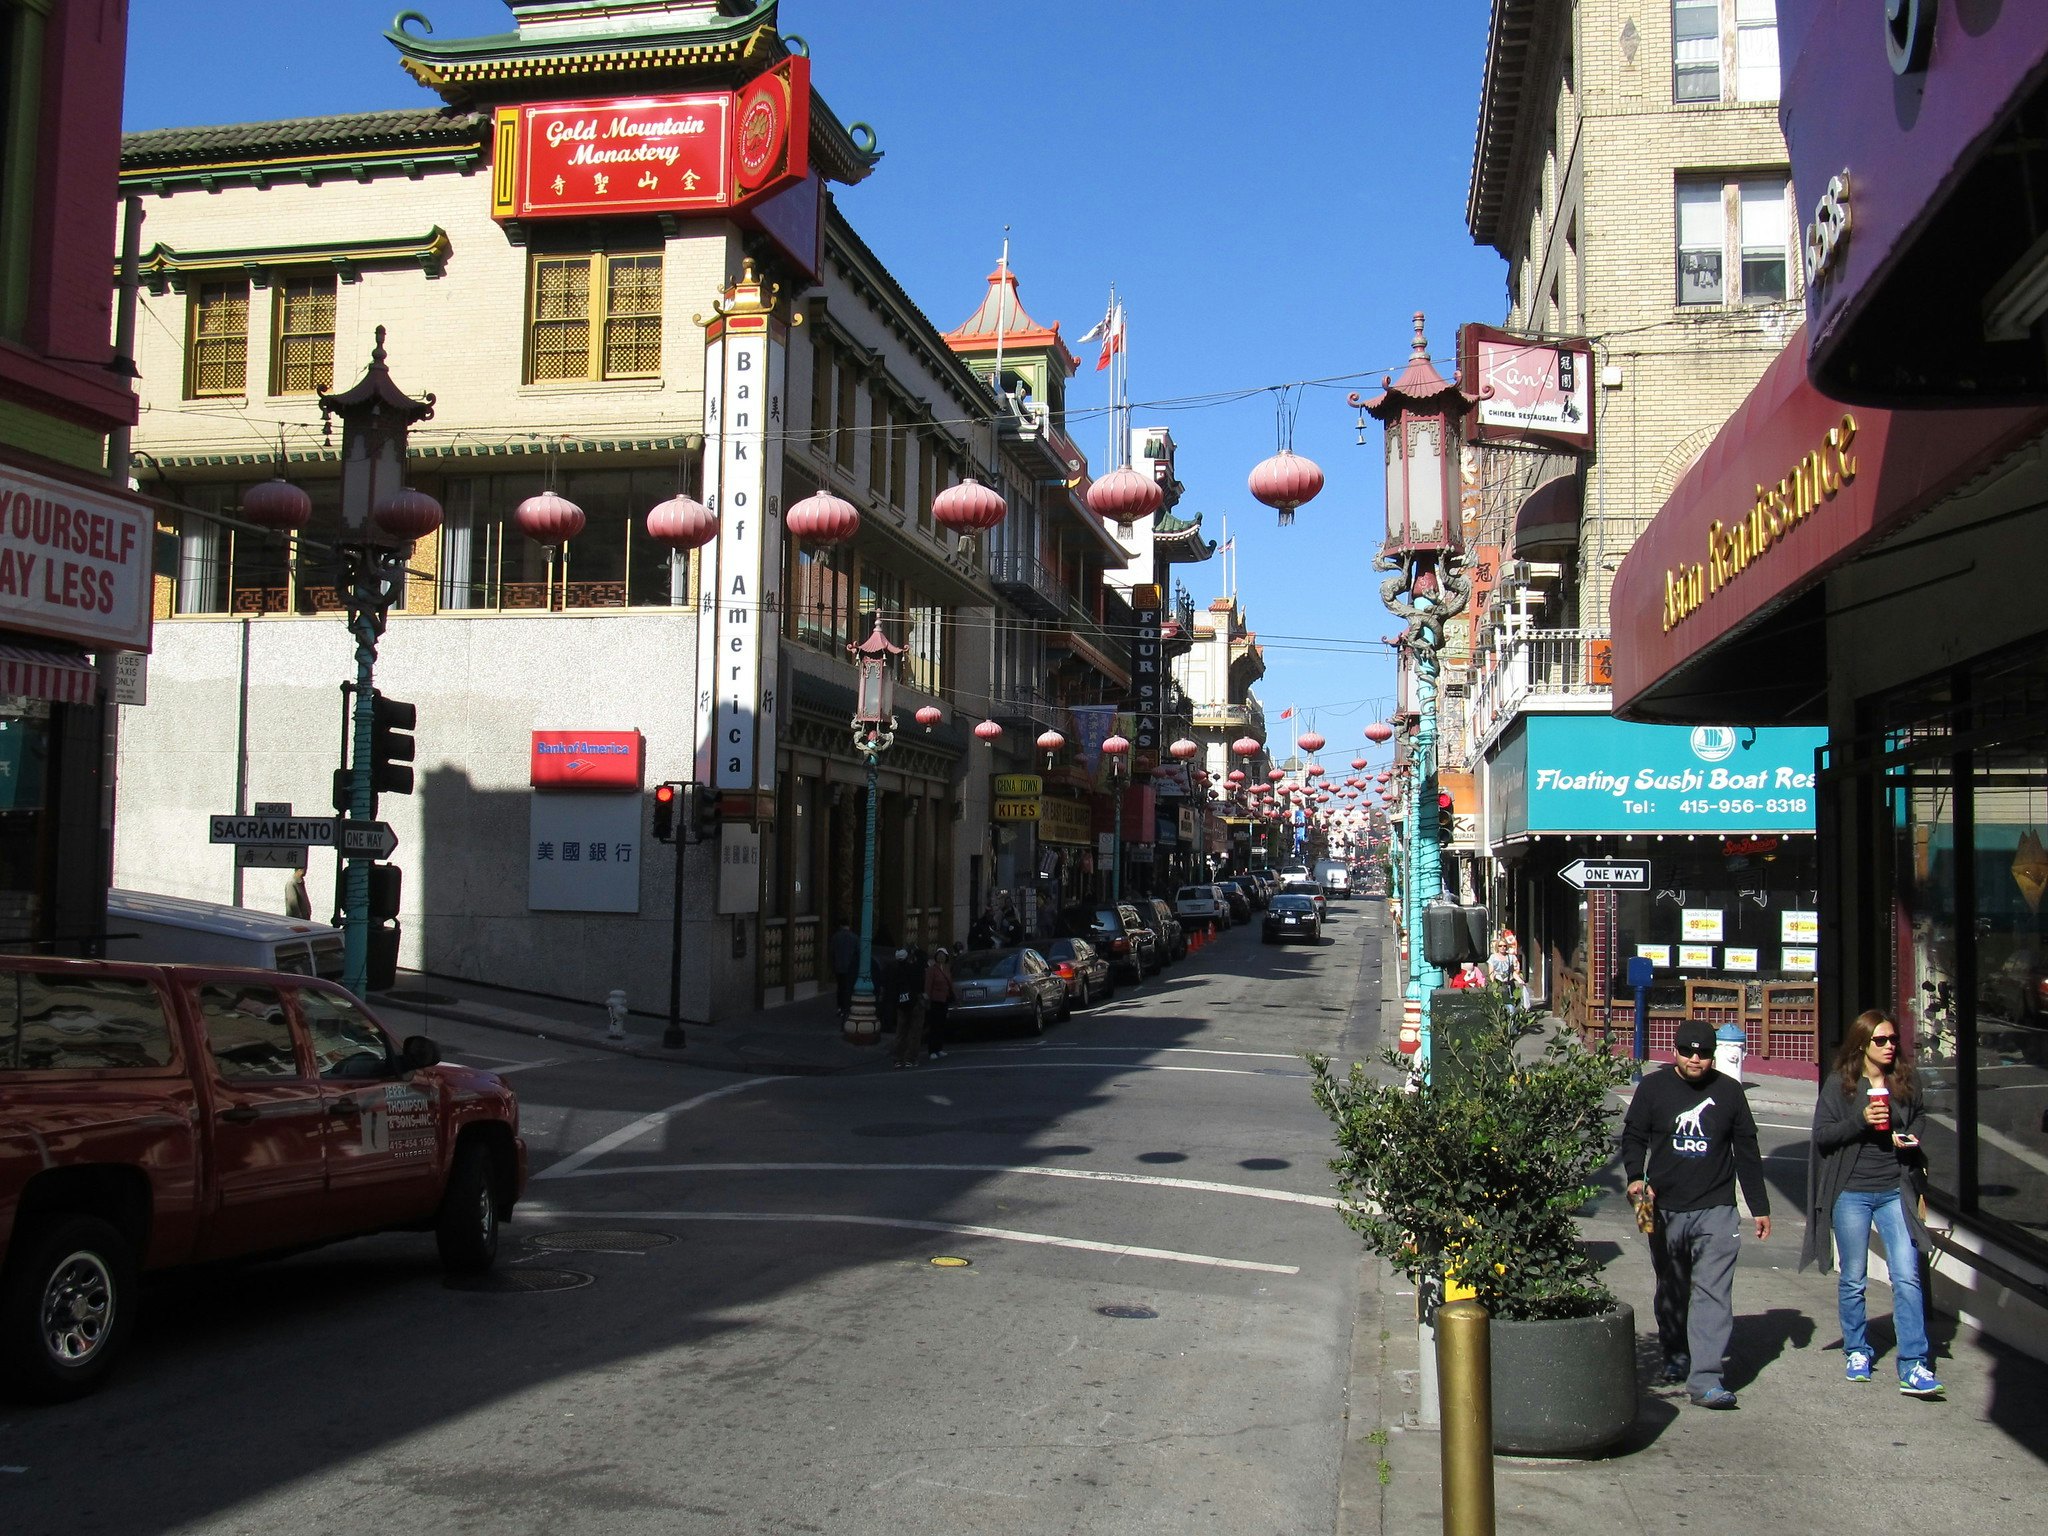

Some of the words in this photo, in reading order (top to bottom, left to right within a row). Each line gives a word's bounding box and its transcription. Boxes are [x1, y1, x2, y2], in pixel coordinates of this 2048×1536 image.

[546, 119, 598, 148] Gold
[601, 115, 705, 139] Mountain
[567, 141, 681, 166] Monastery
[1486, 347, 1555, 396] Kan's
[735, 351, 752, 461] Bank
[1488, 409, 1516, 419] CHINESE
[1518, 412, 1558, 423] RESTAURANT
[734, 491, 747, 541] of
[1662, 562, 1704, 632] Asian
[1709, 413, 1858, 594] Renaissance
[0, 490, 136, 564] YOURSELF
[44, 557, 115, 615] LESS
[1139, 610, 1154, 673] FOUR
[728, 574, 747, 773] America
[1138, 685, 1155, 747] SEAS
[537, 742, 566, 754] Bank
[567, 742, 579, 754] of
[579, 741, 629, 755] America
[997, 780, 1016, 792] CHINA
[1019, 780, 1038, 792] TOWN
[1535, 768, 1630, 797] Floating
[1634, 766, 1704, 793] Sushi
[1708, 767, 1768, 790] Boat
[1774, 766, 1816, 790] Res
[267, 804, 287, 814] 800
[998, 804, 1035, 817] KITES
[1622, 800, 1656, 814] Tel:
[1679, 799, 1807, 814] 415-956-8318
[213, 820, 331, 841] SACRAMENTO
[346, 831, 365, 846] ONE
[366, 832, 383, 847] WAY
[537, 842, 632, 863] 美國銀行
[1585, 869, 1610, 880] ONE
[1613, 869, 1640, 880] WAY
[385, 1085, 407, 1099] JERRY
[387, 1100, 428, 1113] THOMPSON
[419, 1114, 434, 1126] INC.
[1672, 1138, 1708, 1152] LRG
